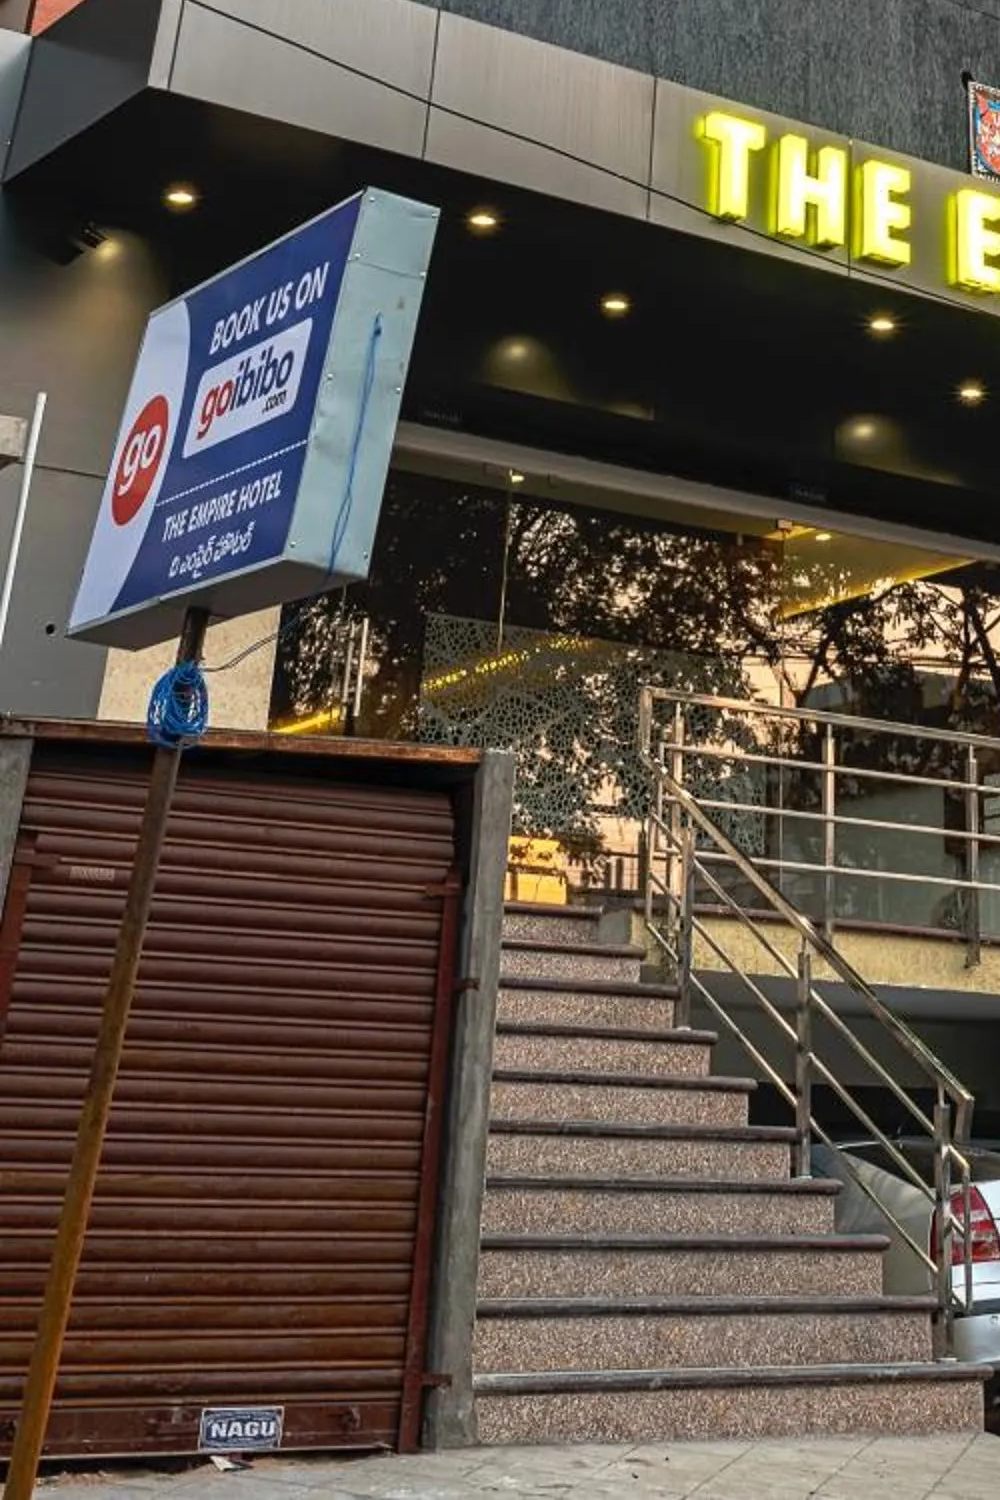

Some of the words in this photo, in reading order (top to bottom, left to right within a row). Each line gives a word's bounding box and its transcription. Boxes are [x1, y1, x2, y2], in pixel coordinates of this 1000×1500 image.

[697, 111, 911, 266] THE
[209, 296, 266, 355] BOOK
[266, 281, 295, 326] US
[295, 261, 330, 311] ON
[197, 344, 294, 440] goibibo
[117, 424, 161, 496] go
[162, 509, 188, 543] THE
[187, 488, 237, 533] EMPIRE
[236, 470, 282, 515] HOTEL
[211, 1421, 277, 1438] NAGU
